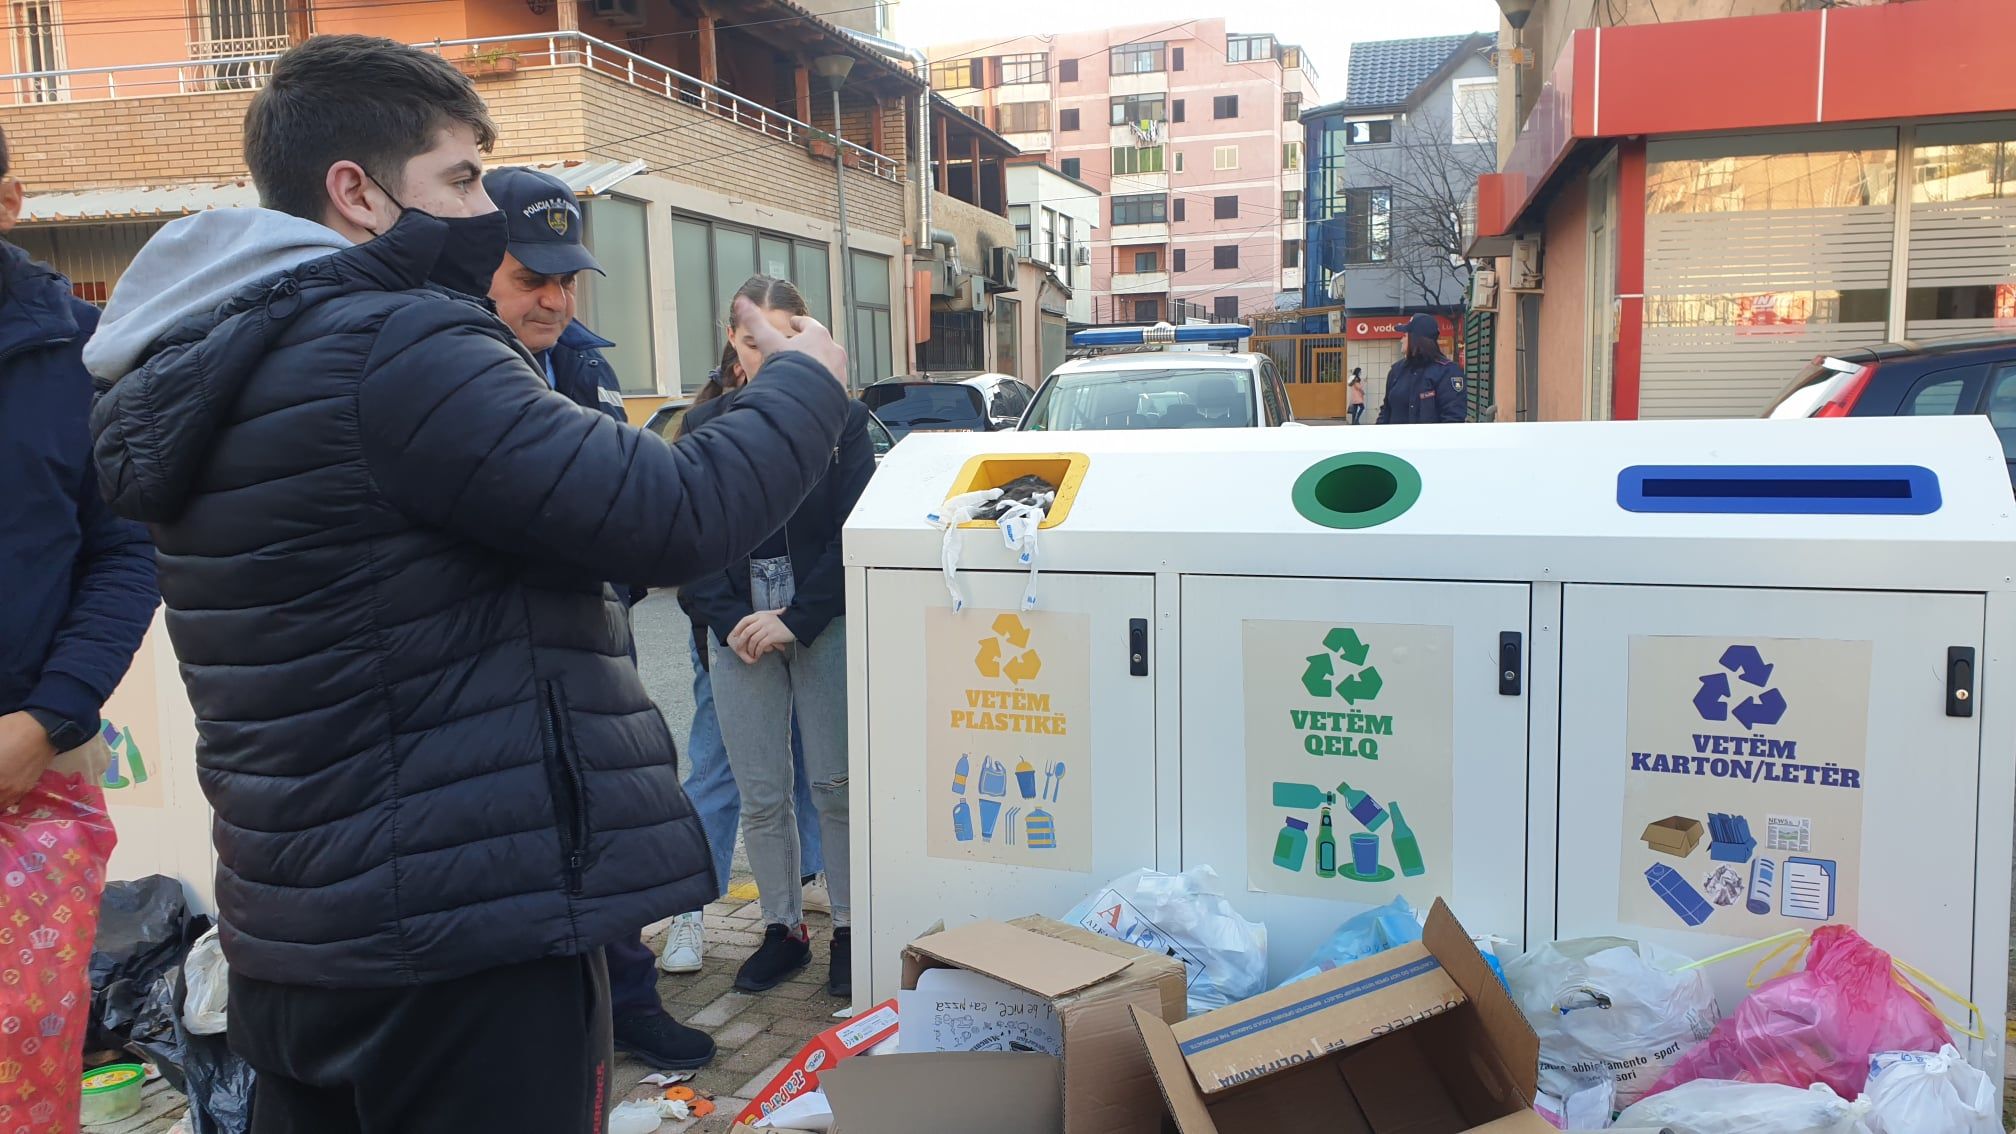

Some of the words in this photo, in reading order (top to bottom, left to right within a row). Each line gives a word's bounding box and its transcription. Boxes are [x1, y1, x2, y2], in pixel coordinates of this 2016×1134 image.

[965, 688, 1051, 712] VETËM
[951, 709, 1067, 735] PLASTIKË
[1290, 709, 1393, 736] VETËM
[1304, 735, 1379, 760] QELQ
[1692, 734, 1797, 760] VETËM
[1631, 752, 1861, 789] KARTON/LETËR
[1375, 977, 1390, 985] OPEN
[1653, 1041, 1680, 1061] sport
